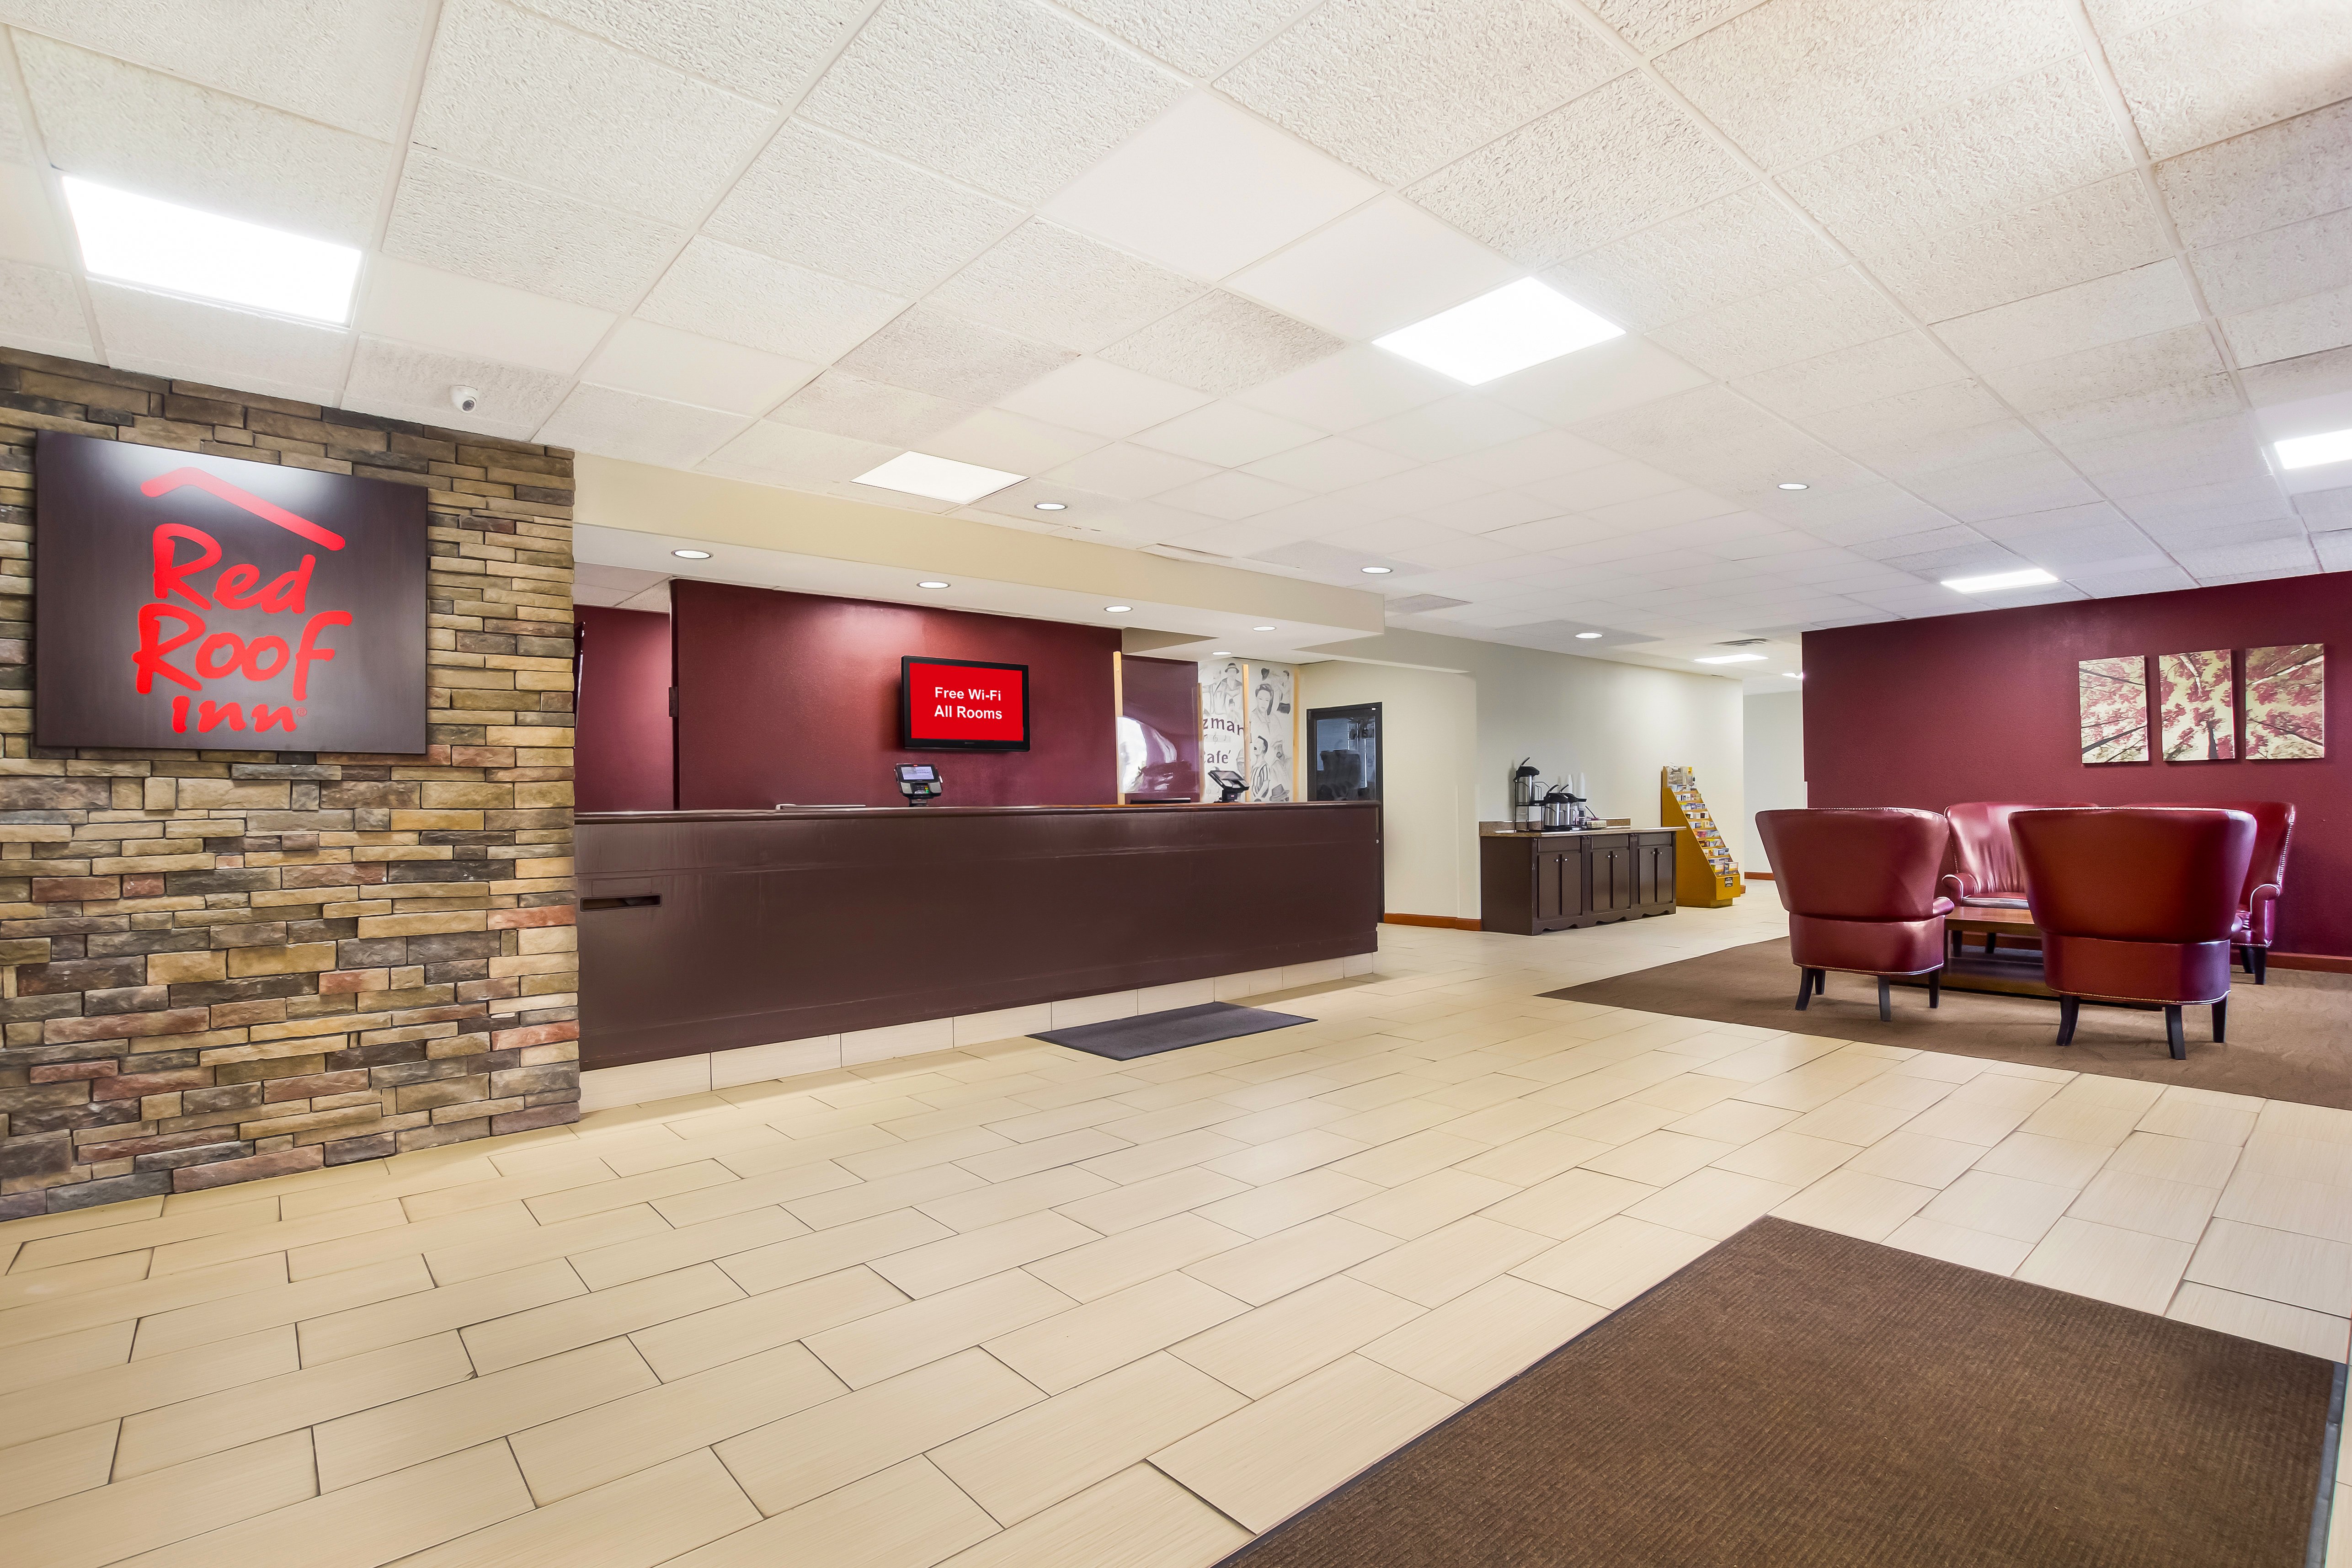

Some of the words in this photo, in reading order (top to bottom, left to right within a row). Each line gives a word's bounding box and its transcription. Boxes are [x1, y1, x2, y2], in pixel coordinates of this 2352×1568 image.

[152, 523, 316, 614] Red
[131, 603, 353, 701] Roof
[934, 704, 952, 718] All
[957, 705, 1003, 720] Rooms
[935, 687, 965, 699] Free
[968, 688, 1001, 701] Wi-Fi
